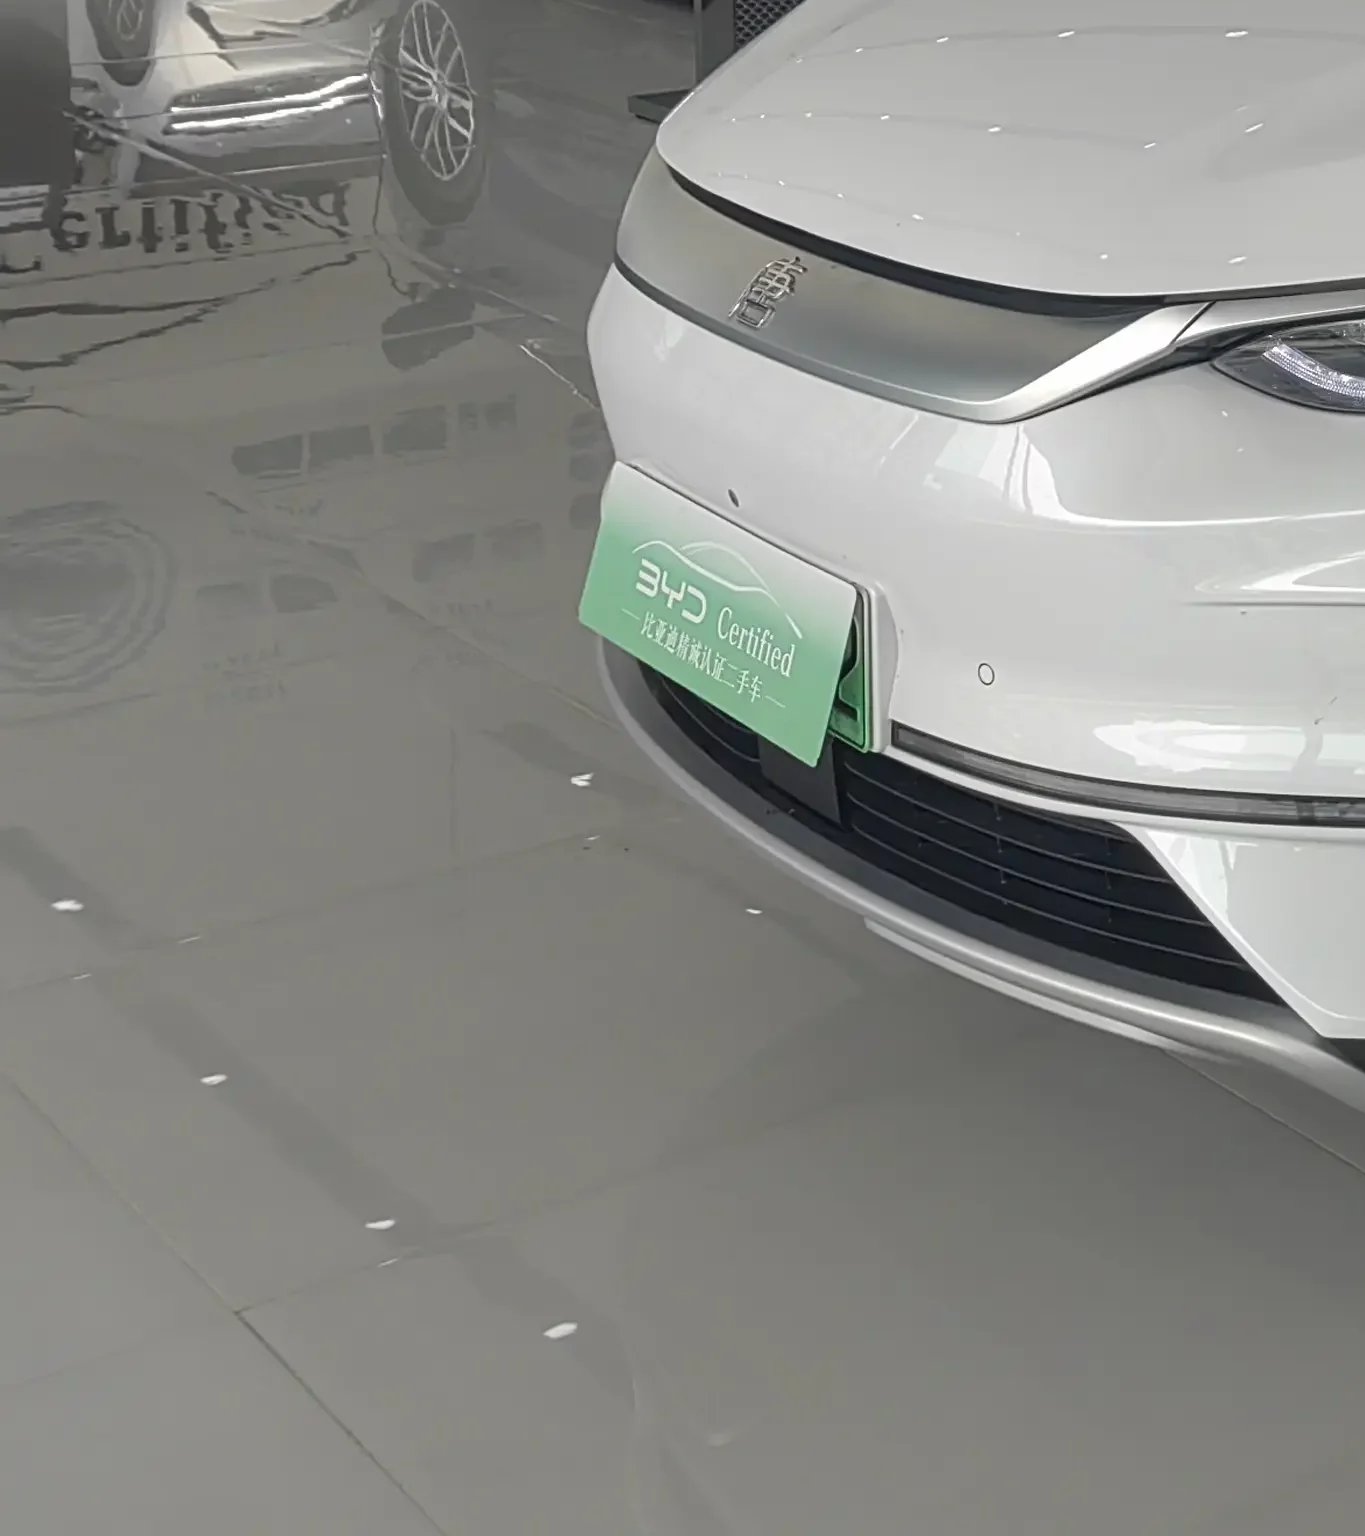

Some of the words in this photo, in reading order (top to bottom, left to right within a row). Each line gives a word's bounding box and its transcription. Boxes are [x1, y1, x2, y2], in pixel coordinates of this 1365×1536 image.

[636, 558, 708, 624] BYD
[717, 607, 797, 677] Certified
[640, 611, 763, 703] 比亚迪精诚认证二手车
